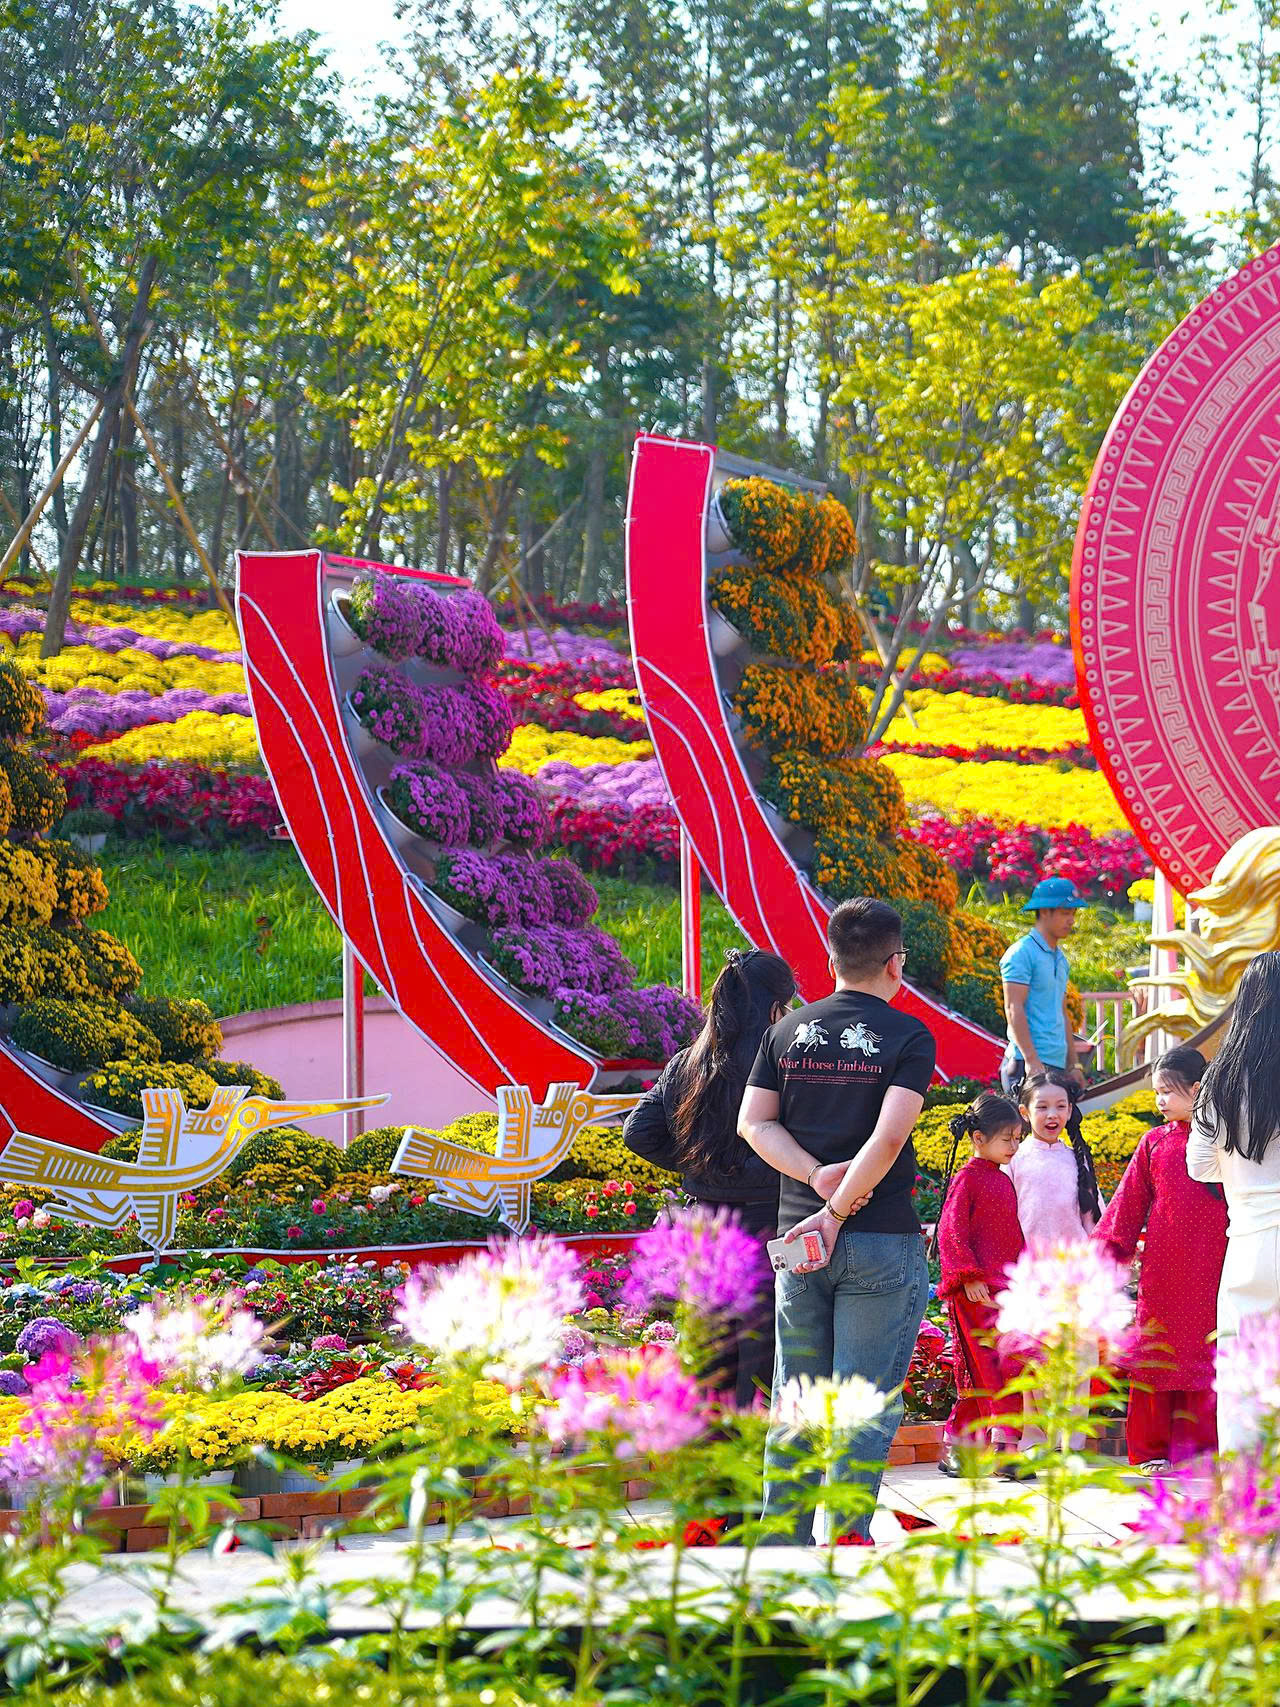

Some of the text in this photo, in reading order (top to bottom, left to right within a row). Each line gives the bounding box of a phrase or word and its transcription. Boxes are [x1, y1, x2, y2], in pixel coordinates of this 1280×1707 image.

[779, 1058, 882, 1073] War Horse Emblem
